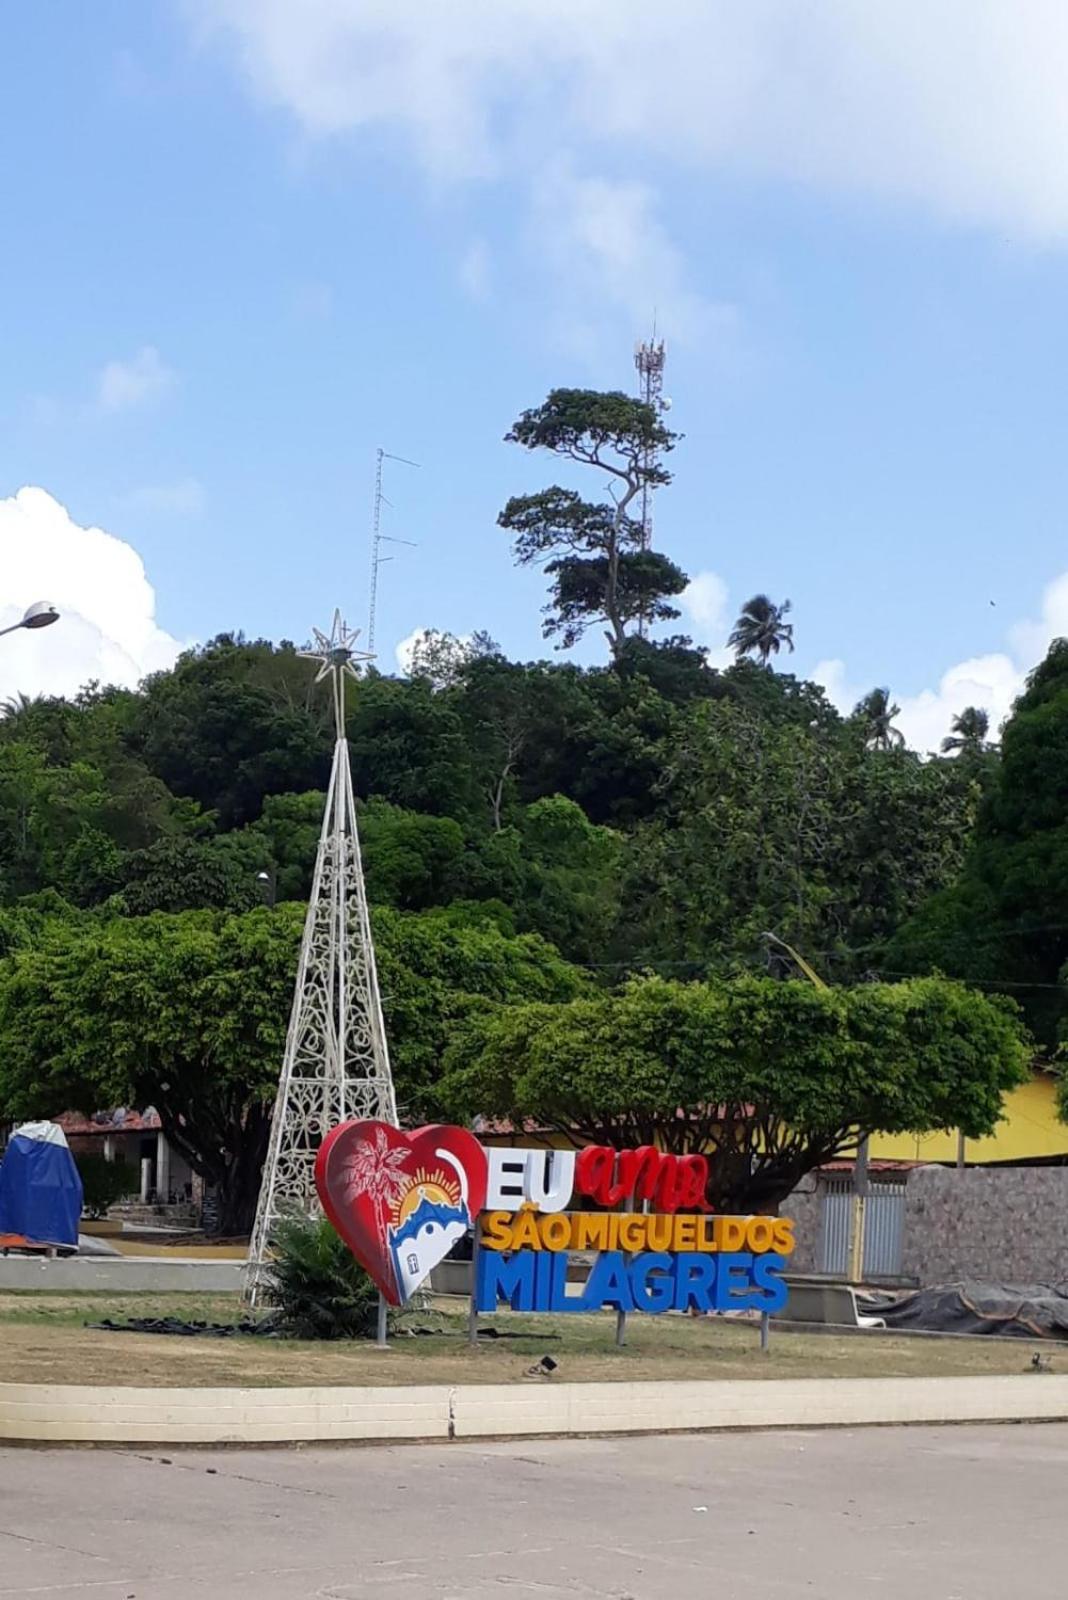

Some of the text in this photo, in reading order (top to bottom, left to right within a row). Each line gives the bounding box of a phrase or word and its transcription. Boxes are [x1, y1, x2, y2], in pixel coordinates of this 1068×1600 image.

[487, 1147, 576, 1213] EU
[481, 1202, 796, 1255] SÃO MIGUEL DOS
[477, 1250, 788, 1313] MILAGRES
